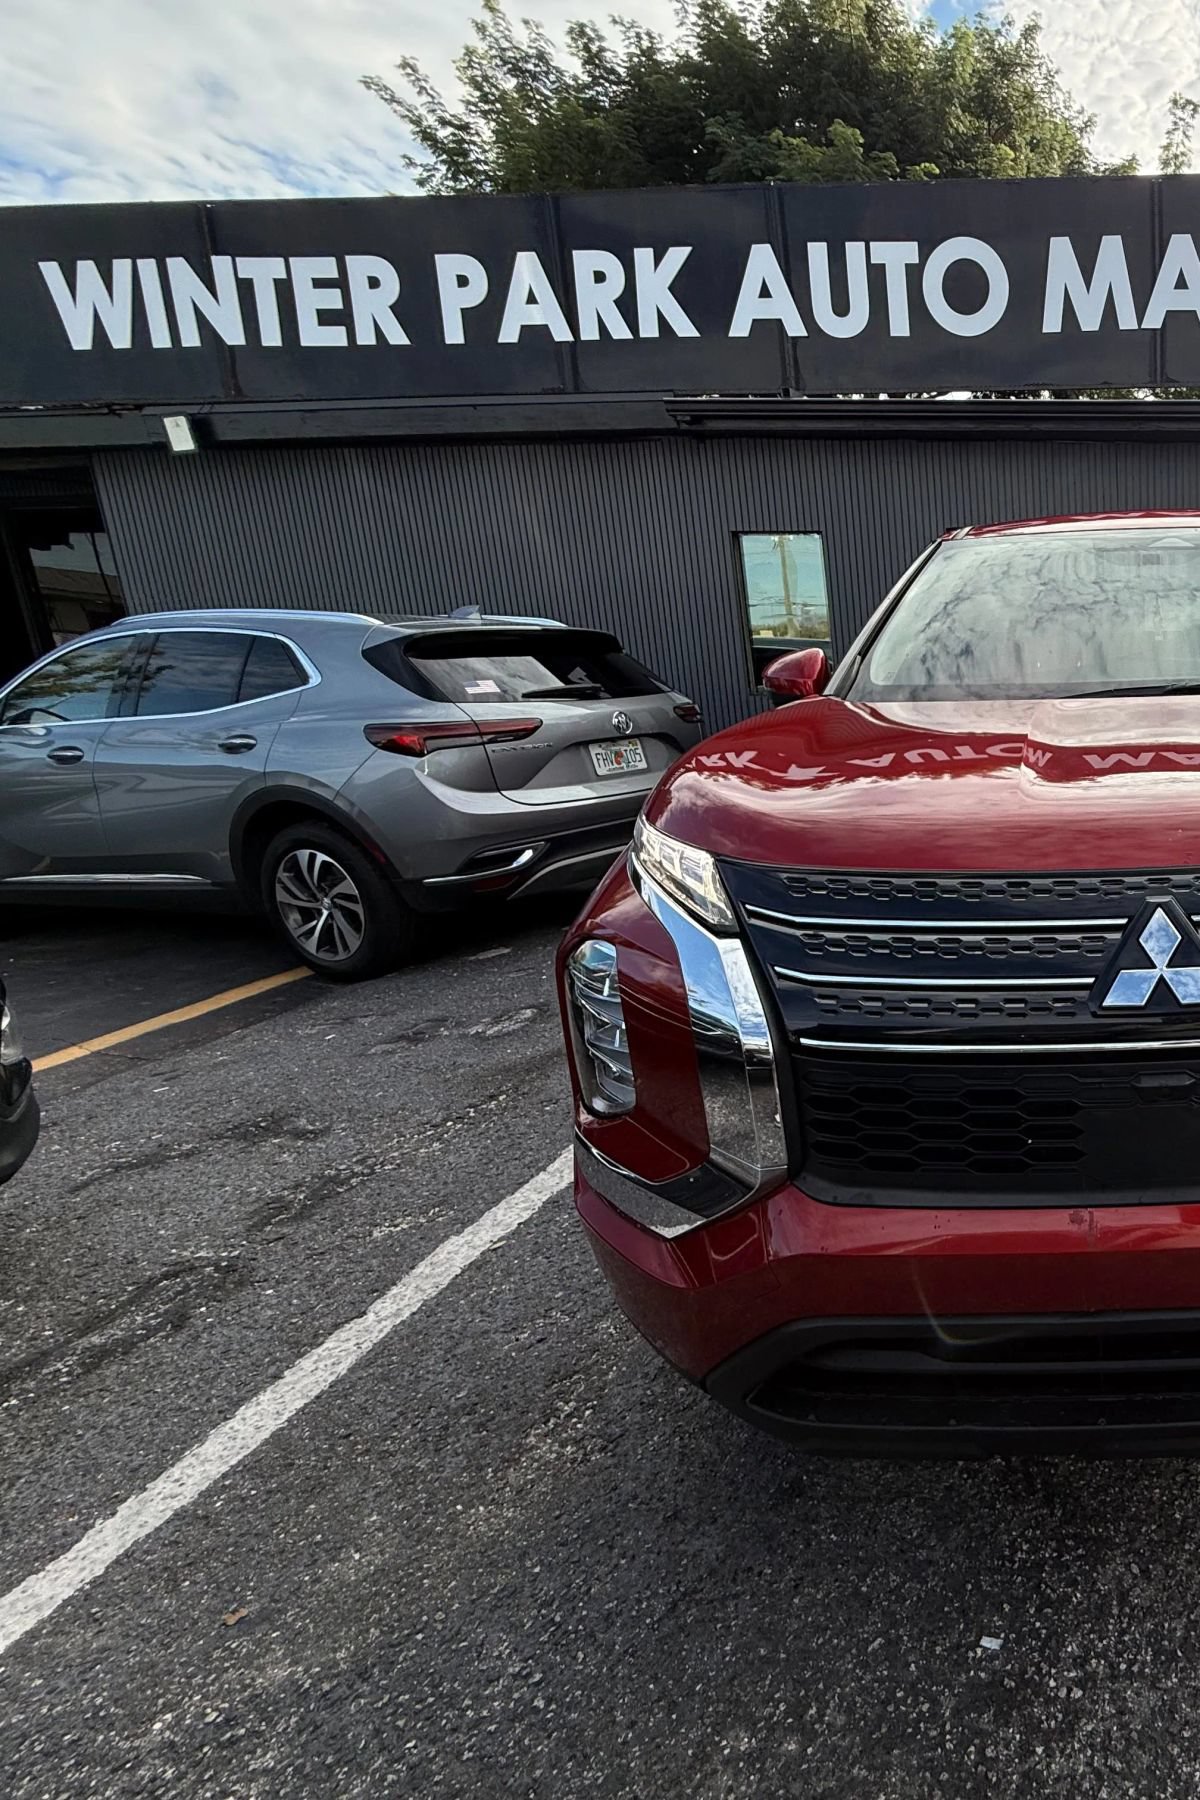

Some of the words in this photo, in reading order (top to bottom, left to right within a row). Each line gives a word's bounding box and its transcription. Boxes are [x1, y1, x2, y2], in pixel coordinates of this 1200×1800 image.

[38, 254, 413, 351] WINTER
[434, 246, 701, 345] PARK
[728, 236, 1009, 338] AUTO
[595, 750, 615, 769] FHV
